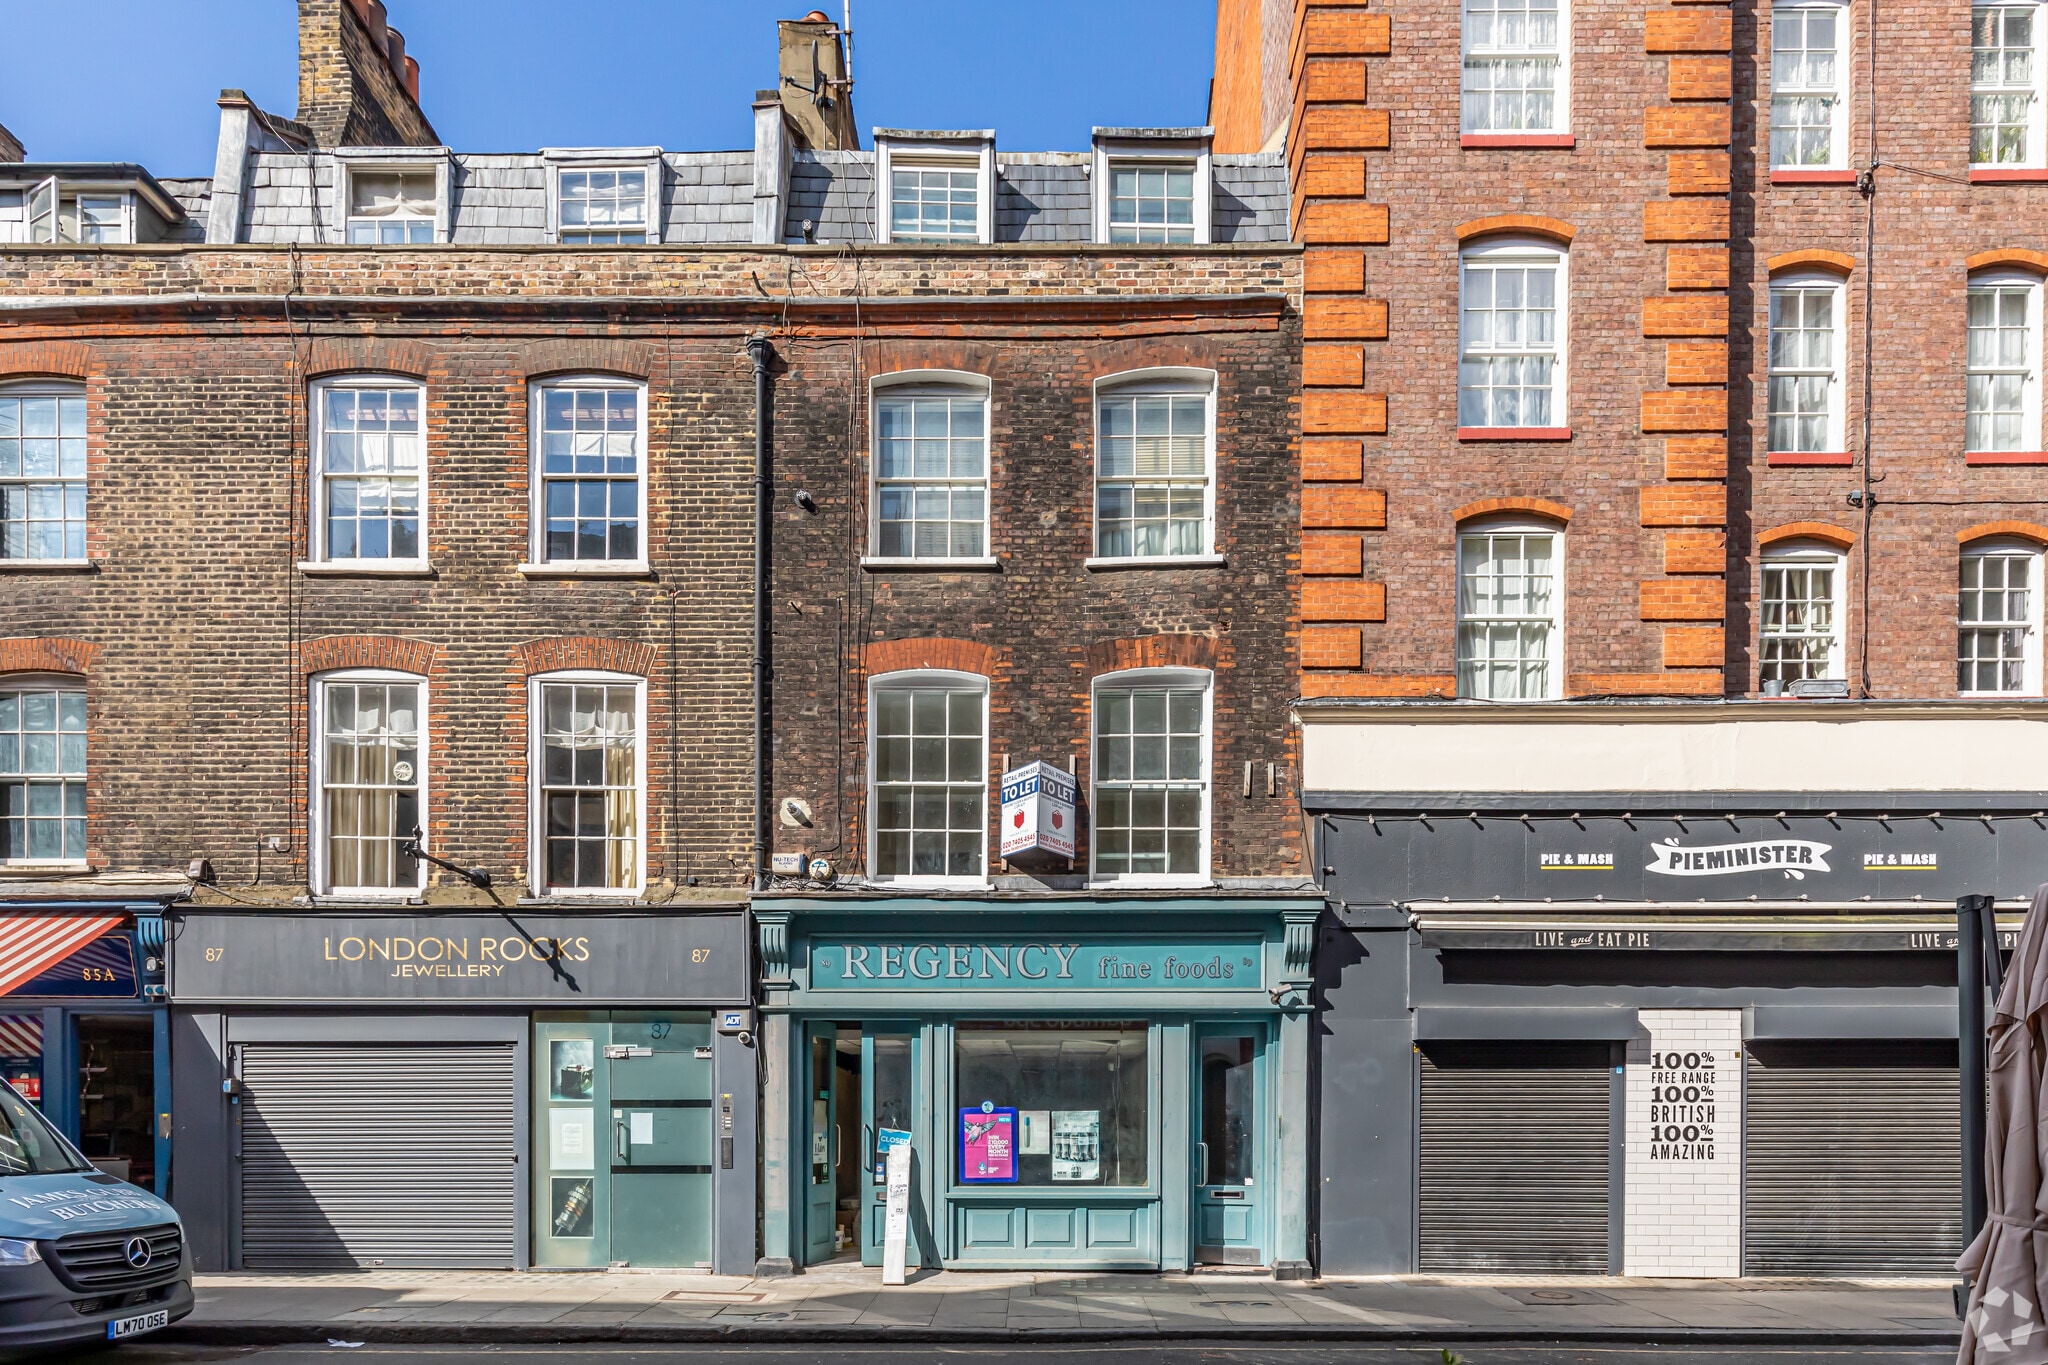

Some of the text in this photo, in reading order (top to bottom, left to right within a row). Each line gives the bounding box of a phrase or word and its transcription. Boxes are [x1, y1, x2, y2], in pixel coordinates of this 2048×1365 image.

[1004, 766, 1037, 784] RETAIL PREMISES
[1041, 766, 1074, 785] RETAIL PREMISES
[1003, 786, 1018, 802] TO
[1020, 777, 1037, 796] LET
[1041, 778, 1055, 795] TO
[1057, 784, 1074, 803] LET
[1541, 853, 1614, 865] PIE & MASH
[1669, 845, 1813, 870] PIEMINISTER
[1864, 853, 1937, 865] PIE & MASH
[324, 936, 590, 962] LONDON ROCKS
[1535, 932, 1650, 948] LIVE and EAT PIE
[1911, 933, 1941, 947] LIVE
[2004, 933, 2018, 947] PI
[205, 947, 224, 962] 87
[691, 948, 710, 963] 87
[841, 943, 1234, 979] REGENCY fine foods
[82, 968, 116, 982] 85A
[390, 964, 504, 977] JEWELLERY
[725, 1015, 741, 1026] ADT
[651, 1024, 672, 1040] 87
[1651, 1051, 1715, 1070] 100%
[1652, 1072, 1715, 1083] FREE RANGE
[1651, 1085, 1714, 1103] 100%
[1651, 1105, 1715, 1123] BRITISH
[880, 1135, 910, 1145] CLOSED
[1651, 1124, 1714, 1142] 100%
[1651, 1144, 1715, 1160] AMAZING
[8, 1189, 88, 1210] JAMES
[50, 1199, 161, 1221] BUTCHERS
[115, 1312, 166, 1336] LM70 OSE
